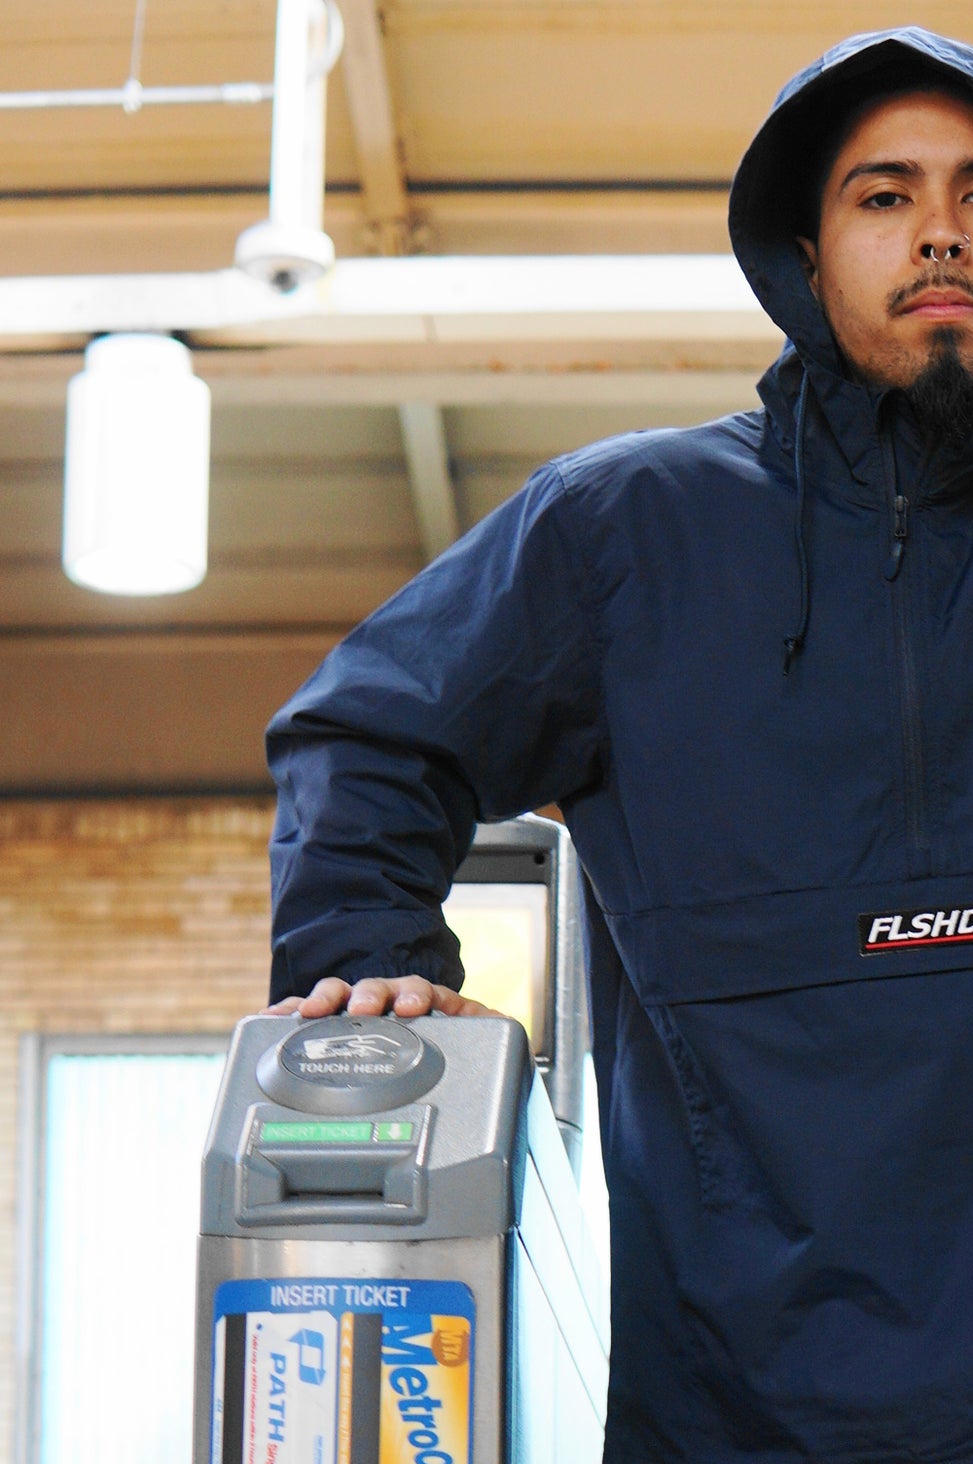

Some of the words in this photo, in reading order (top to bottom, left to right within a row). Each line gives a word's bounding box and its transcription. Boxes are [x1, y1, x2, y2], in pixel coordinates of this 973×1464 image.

[299, 1062, 349, 1074] TOUCH
[353, 1063, 396, 1075] HERE
[269, 1126, 315, 1138] INSERT
[320, 1126, 367, 1138] TICKET
[270, 1285, 338, 1306] INSERT
[342, 1286, 411, 1308] TICKET
[266, 1352, 288, 1442] PATH
